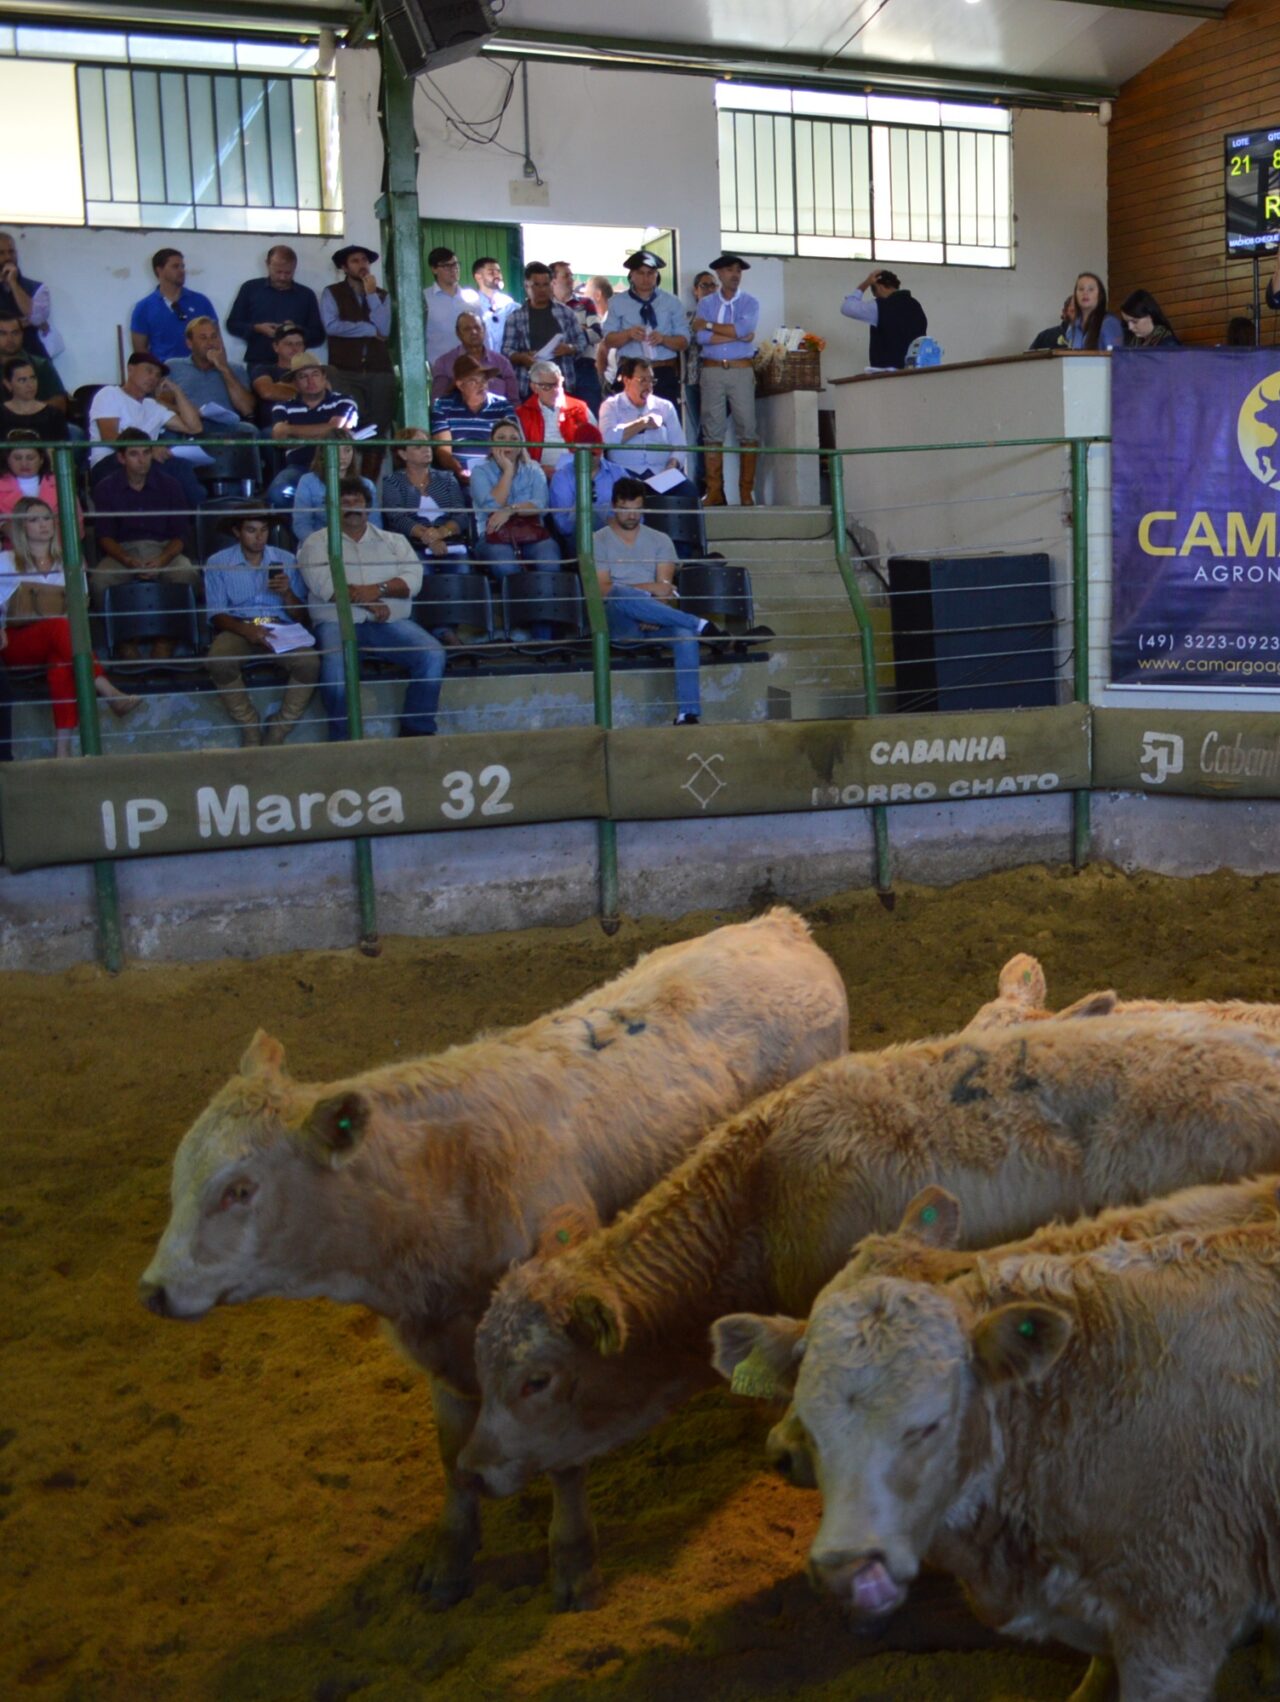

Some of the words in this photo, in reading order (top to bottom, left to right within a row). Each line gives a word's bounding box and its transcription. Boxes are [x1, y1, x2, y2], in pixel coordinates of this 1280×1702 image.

[1232, 137, 1250, 148] LOTE
[1231, 155, 1251, 176] 21
[1138, 634, 1174, 651] (49)
[1184, 635, 1280, 651] 3223-0923
[870, 736, 1007, 766] CABANHA
[197, 784, 405, 838] Marca
[440, 764, 515, 820] 32
[812, 781, 937, 806] MORRO
[948, 772, 1060, 796] CHATO
